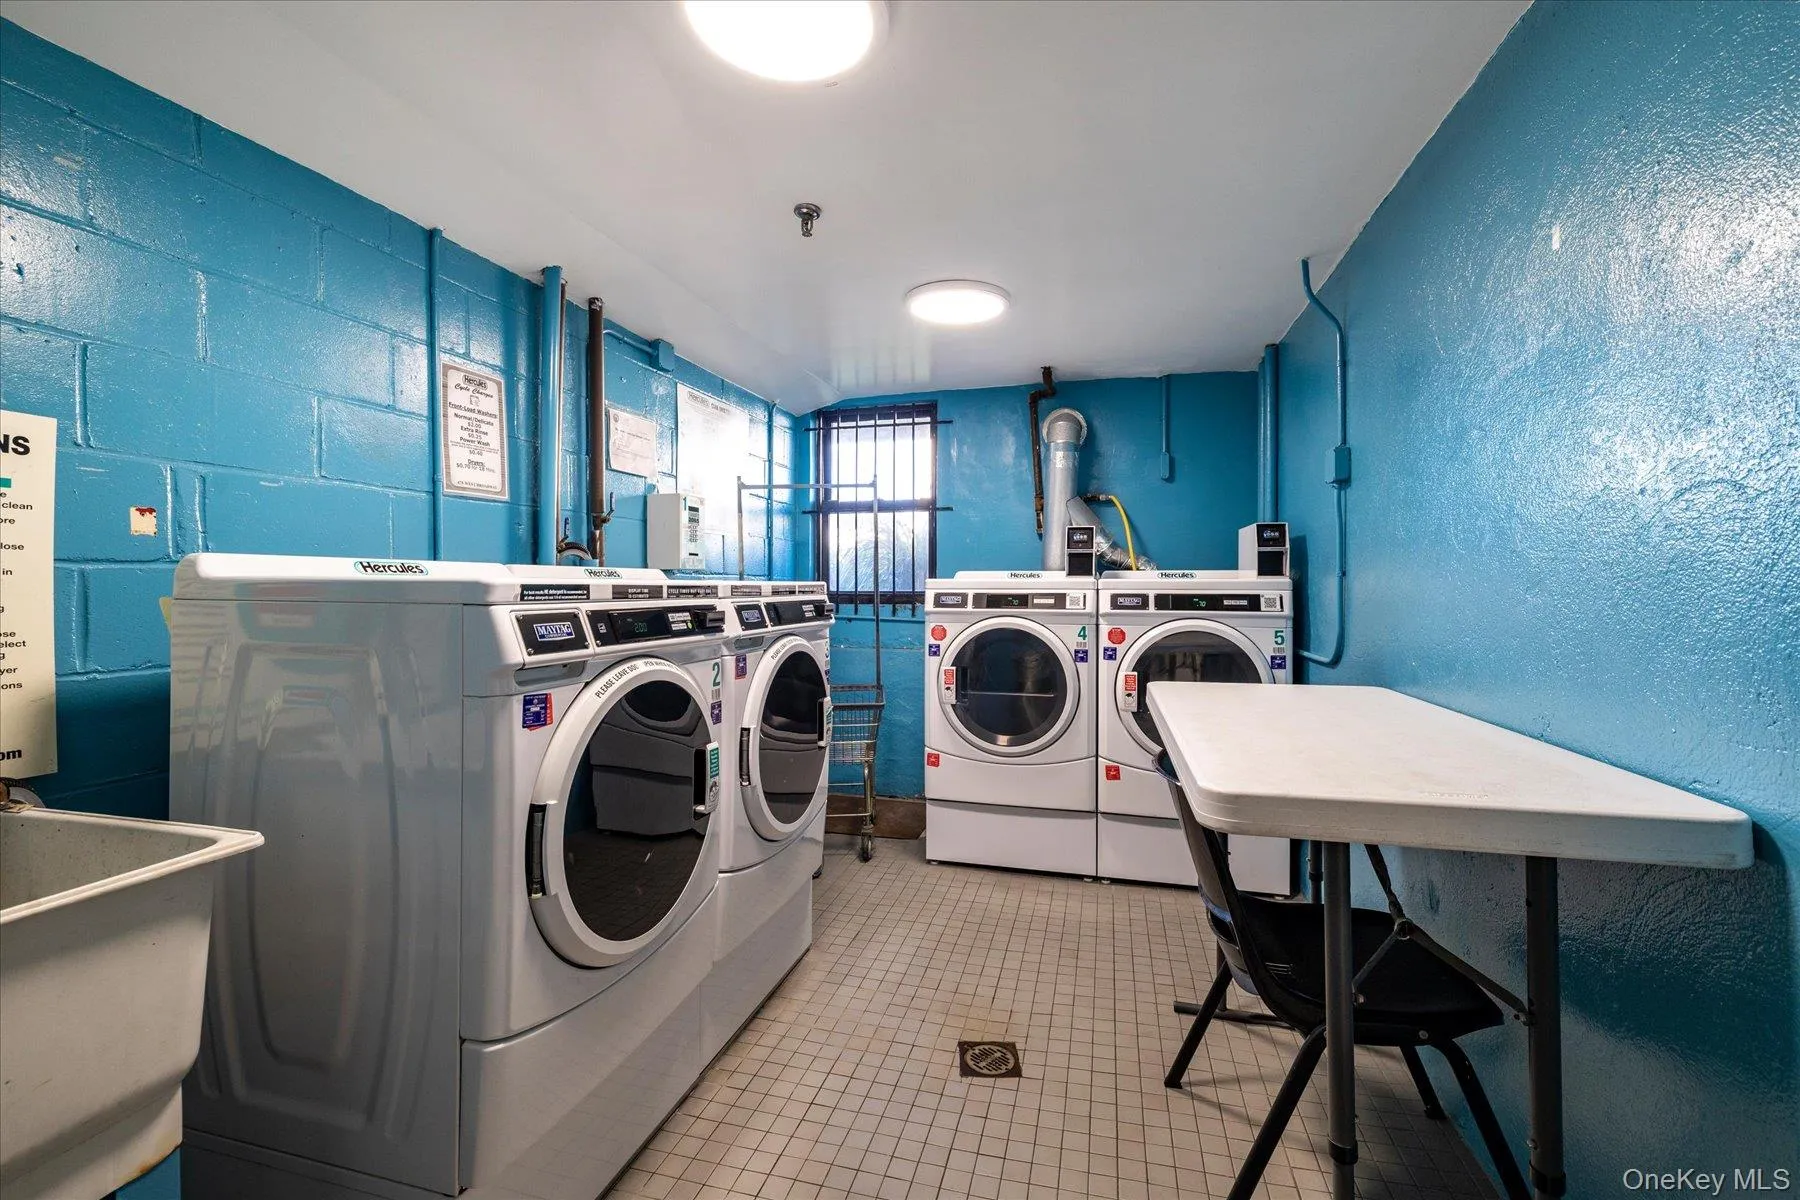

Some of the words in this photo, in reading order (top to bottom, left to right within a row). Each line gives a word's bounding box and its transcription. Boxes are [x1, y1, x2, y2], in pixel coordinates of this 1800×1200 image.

[454, 412, 494, 426] Normal/Delicate
[1, 501, 33, 511] clean
[2, 567, 13, 576] in
[359, 561, 424, 574] Hercules
[586, 568, 620, 578] Hercules
[537, 624, 571, 636] MAYTAG
[1077, 625, 1088, 641] 4
[1274, 630, 1285, 646] 5
[712, 662, 721, 687] 2
[1, 682, 23, 690] ons
[595, 679, 616, 699] PLEASE
[612, 668, 629, 681] LEAVE
